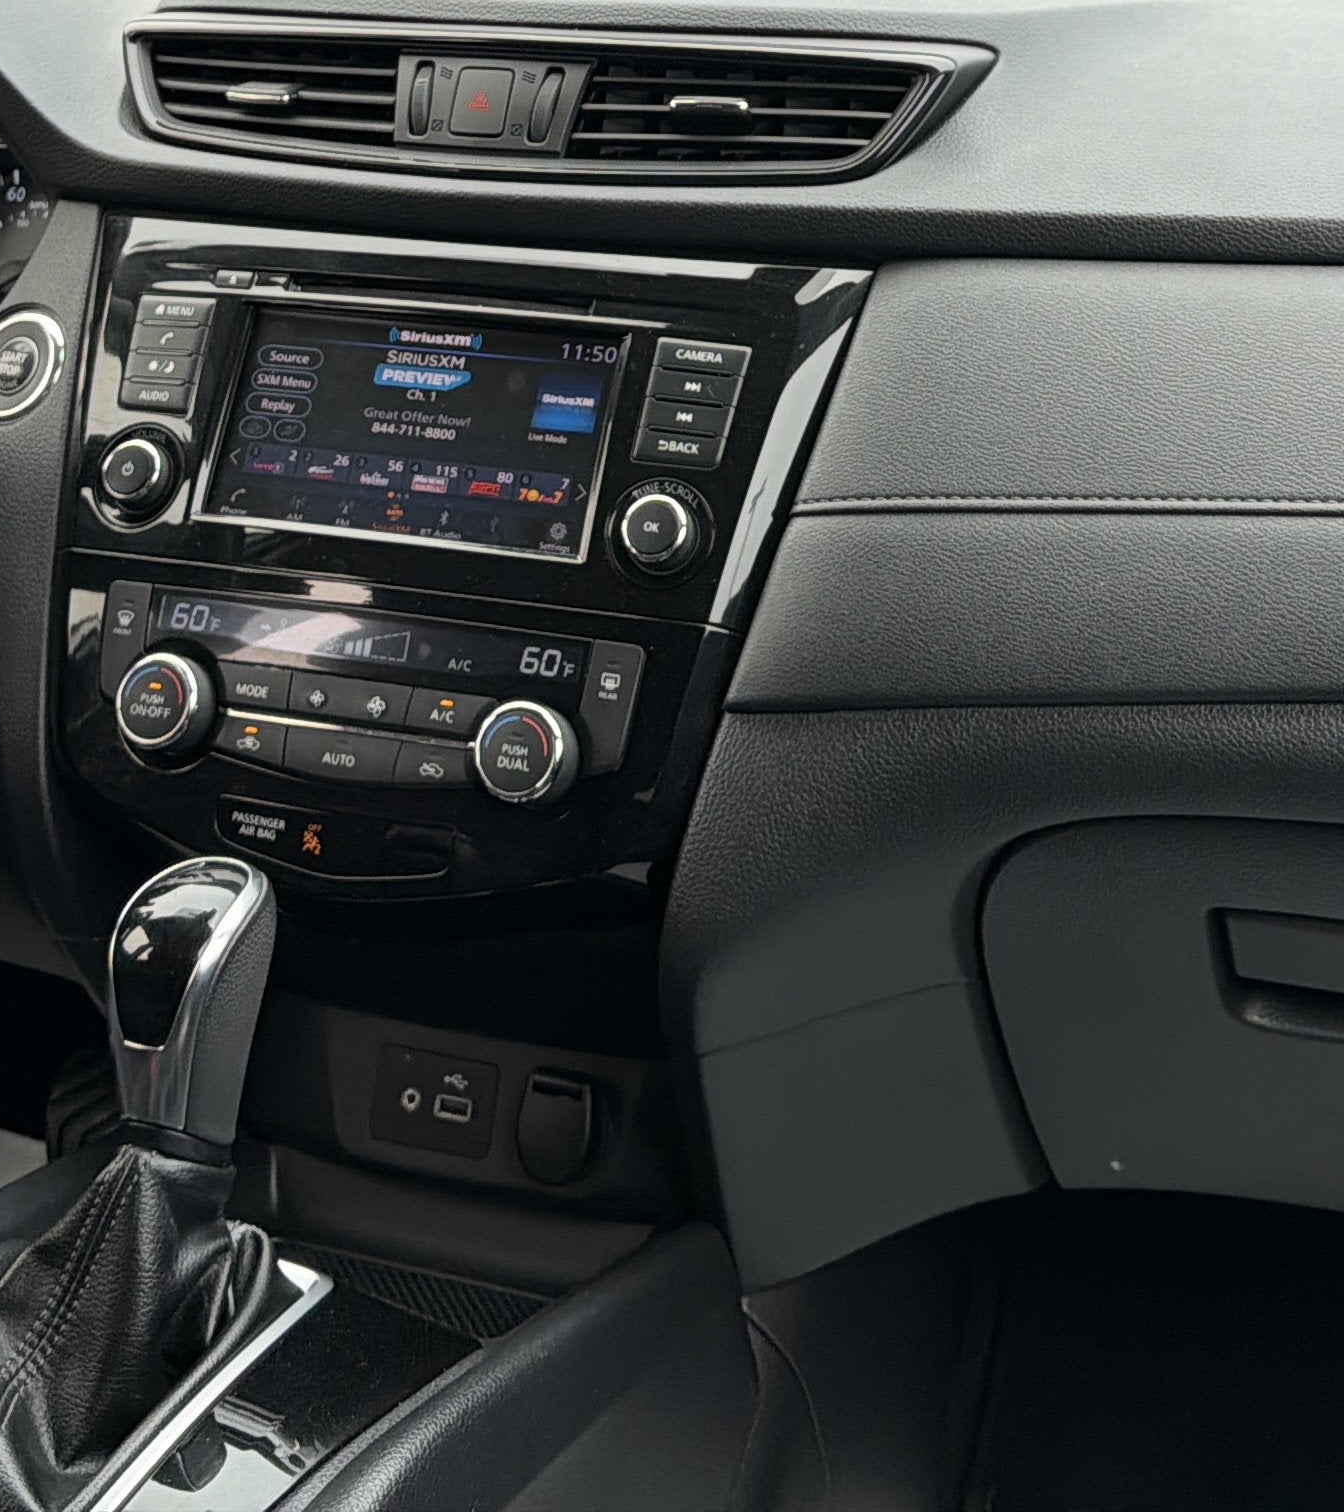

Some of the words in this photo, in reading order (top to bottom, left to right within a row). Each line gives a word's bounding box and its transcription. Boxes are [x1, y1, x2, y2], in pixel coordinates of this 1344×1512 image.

[7, 186, 26, 203] 60
[166, 305, 195, 316] MENU
[269, 350, 310, 364] Source
[561, 343, 618, 364] 11:50
[675, 348, 723, 364] CAMERA
[256, 373, 281, 386] SXM
[282, 375, 312, 389] Menu
[382, 368, 464, 386] PREVIEW
[138, 390, 170, 402] AUDIO
[406, 389, 425, 401] Ch.
[430, 391, 437, 402] 1
[260, 397, 296, 413] Replay
[364, 407, 398, 420] Great
[401, 410, 435, 424] Offer
[437, 414, 472, 428] Now!
[371, 422, 457, 441] 844-711-8800
[527, 432, 544, 442] Live
[544, 433, 568, 445] Mode
[669, 441, 699, 455] BACK
[288, 449, 298, 462] 2
[333, 454, 350, 467] 26
[387, 460, 404, 473] 56
[436, 465, 458, 478] 115
[497, 472, 514, 484] 80
[561, 478, 571, 490] 7
[219, 505, 248, 515] Phone
[286, 513, 304, 521] AM
[335, 518, 350, 527] FM
[643, 521, 660, 533] OK
[420, 528, 432, 536] BT
[434, 529, 461, 540] Audio
[539, 541, 571, 553] Settings
[447, 657, 473, 672] A/C
[235, 682, 269, 699] MODE
[140, 692, 165, 705] PUSH
[429, 709, 455, 724] A/C
[501, 743, 529, 755] PUSH
[321, 751, 356, 767] AUTO
[497, 756, 530, 772] DUAL
[231, 810, 286, 831] PASSENGER
[238, 824, 255, 837] AIR
[256, 827, 277, 841] BAG
[307, 823, 323, 833] OFF
